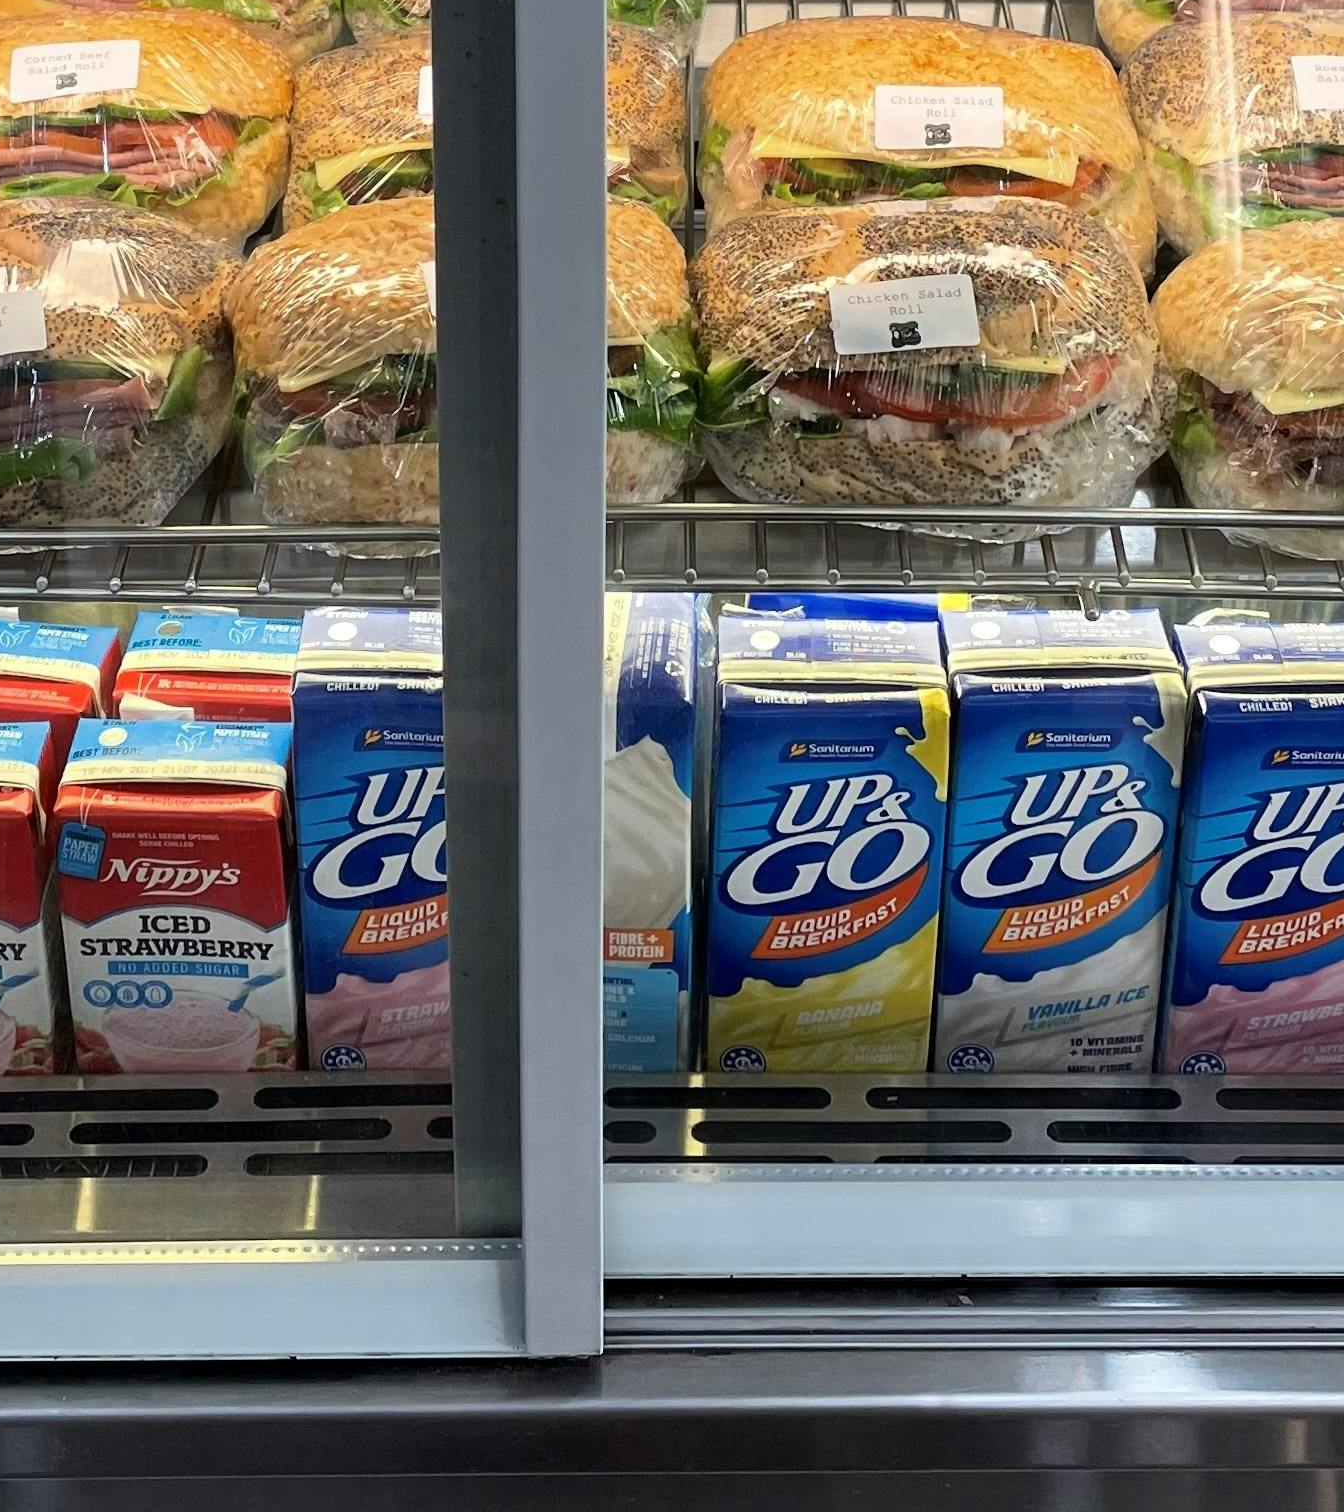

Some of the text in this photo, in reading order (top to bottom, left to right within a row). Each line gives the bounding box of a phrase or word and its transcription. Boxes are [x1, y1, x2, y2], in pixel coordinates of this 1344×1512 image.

[848, 287, 962, 305] Chicken Salad
[889, 303, 923, 316] Roll
[809, 743, 874, 754] Sanitarium
[1046, 732, 1111, 743] Sanitarium
[776, 774, 911, 833] UP&
[1011, 764, 1144, 826] UP&
[64, 838, 99, 852] PAPER
[960, 810, 1164, 899] GO
[61, 850, 98, 864] STRAW
[727, 822, 930, 905] GO
[100, 859, 240, 896] Nippy's
[777, 909, 851, 936] LIQUID
[1002, 885, 1130, 940] BREAKFAST
[1010, 898, 1083, 926] LIQUID
[139, 915, 211, 934] ICED
[770, 898, 898, 950] BREAKFAST
[1247, 911, 1321, 939] LIQUID
[80, 939, 273, 960] STRAWBERRY
[610, 933, 644, 944] FIBRE
[609, 945, 664, 958] PROTEIN
[118, 963, 239, 975] NO ADDED SUGAR
[796, 1001, 884, 1023] BANANA
[1027, 985, 1149, 1021] VANILLA ICE
